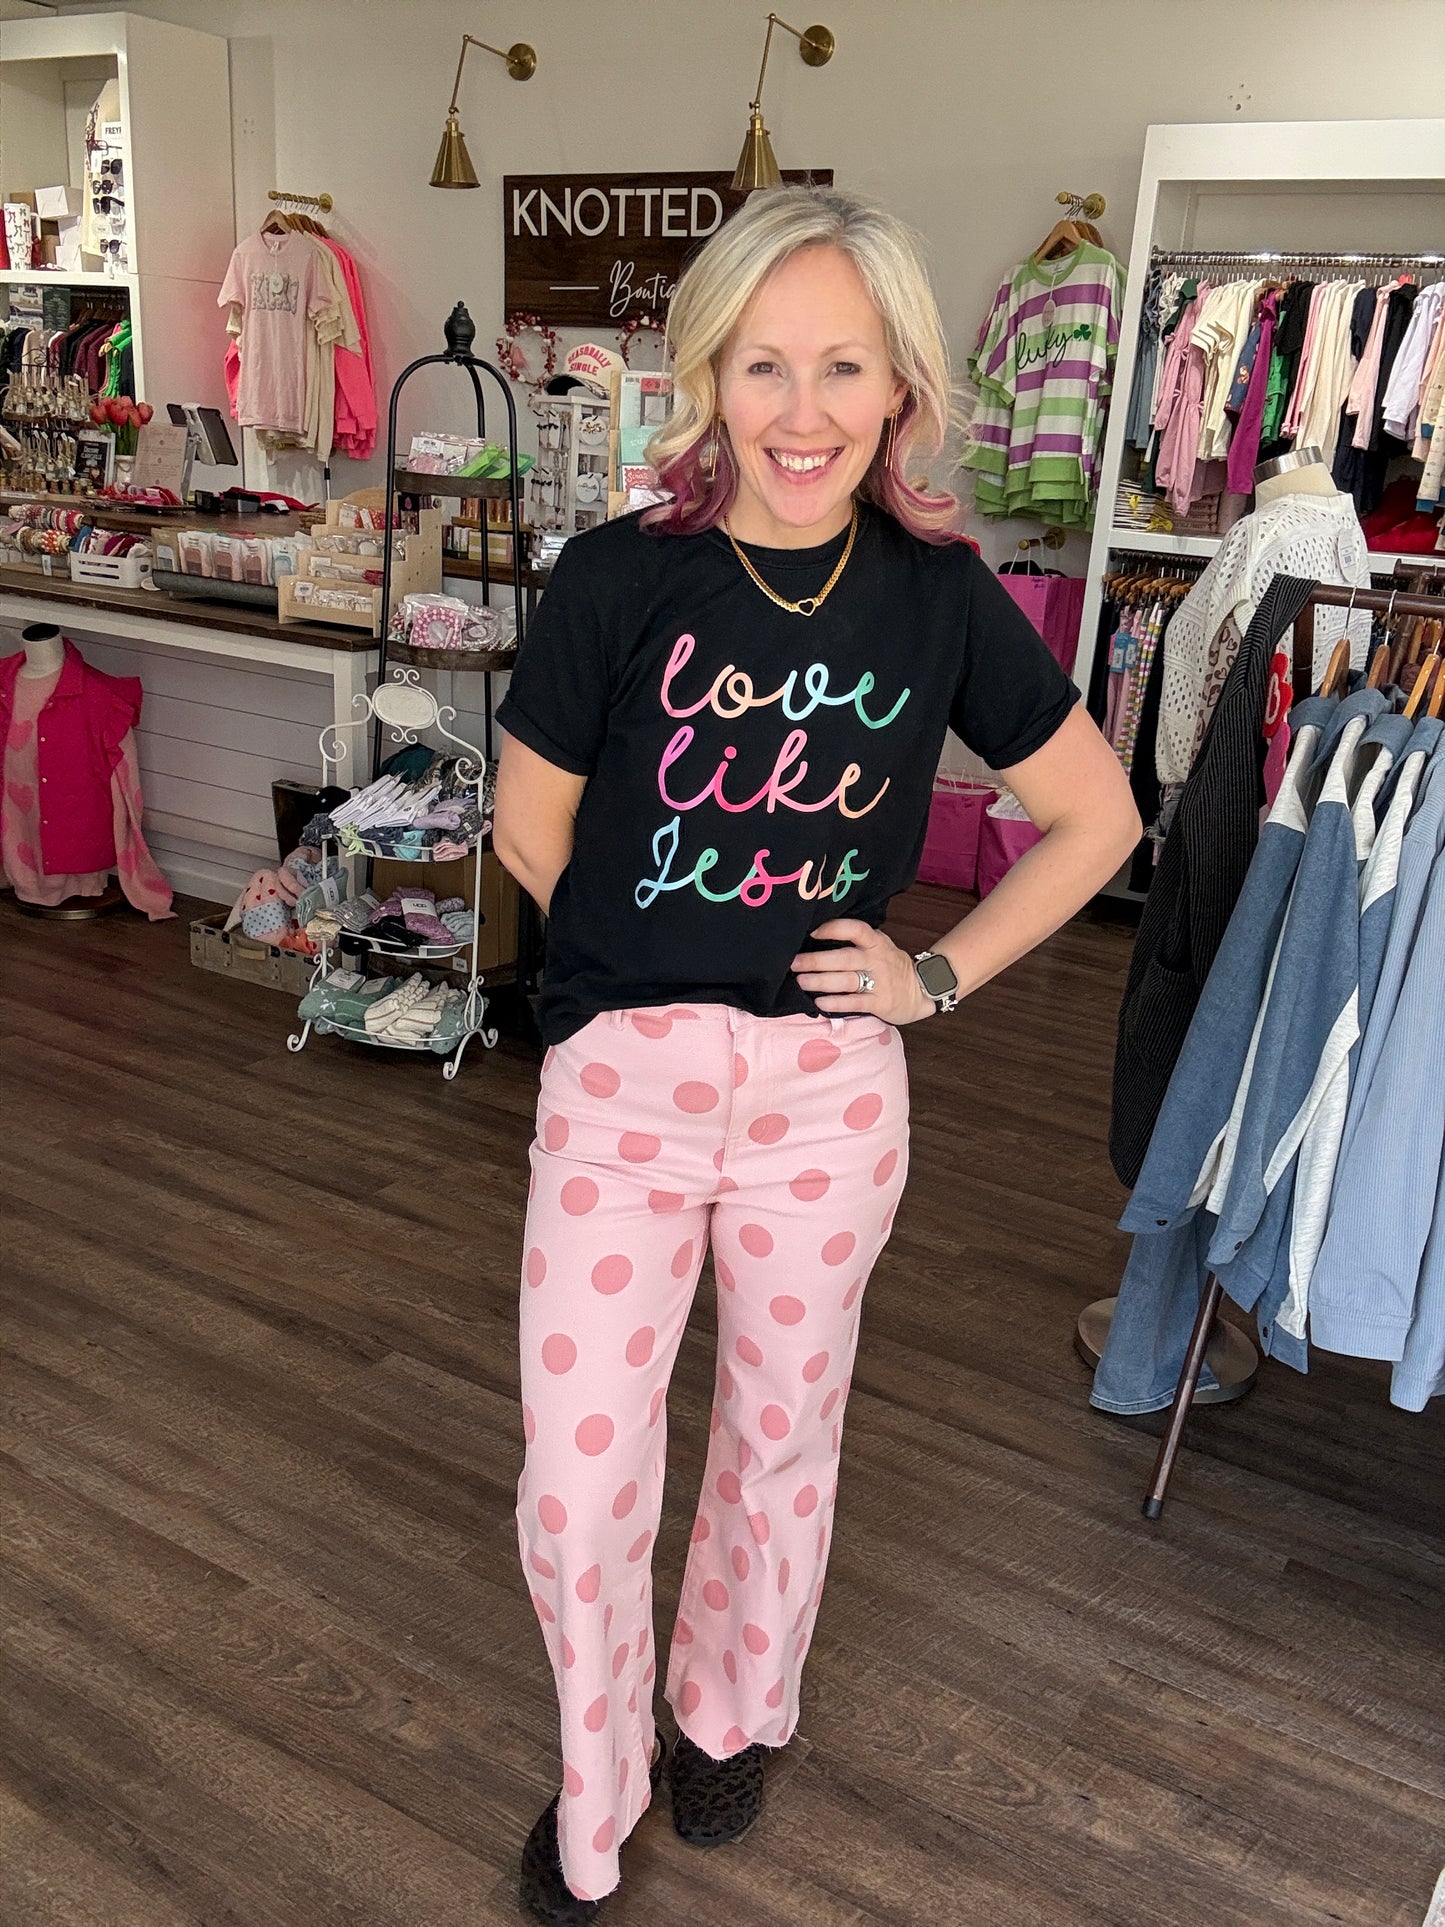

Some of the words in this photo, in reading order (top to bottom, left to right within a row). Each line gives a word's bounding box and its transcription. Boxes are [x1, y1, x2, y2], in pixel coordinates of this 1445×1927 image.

[513, 187, 723, 237] KNOTTED
[567, 346, 612, 369] SEASONALLY
[568, 361, 599, 376] SINGLE
[660, 633, 911, 729] love
[658, 725, 890, 819] like
[635, 815, 870, 909] Jesus
